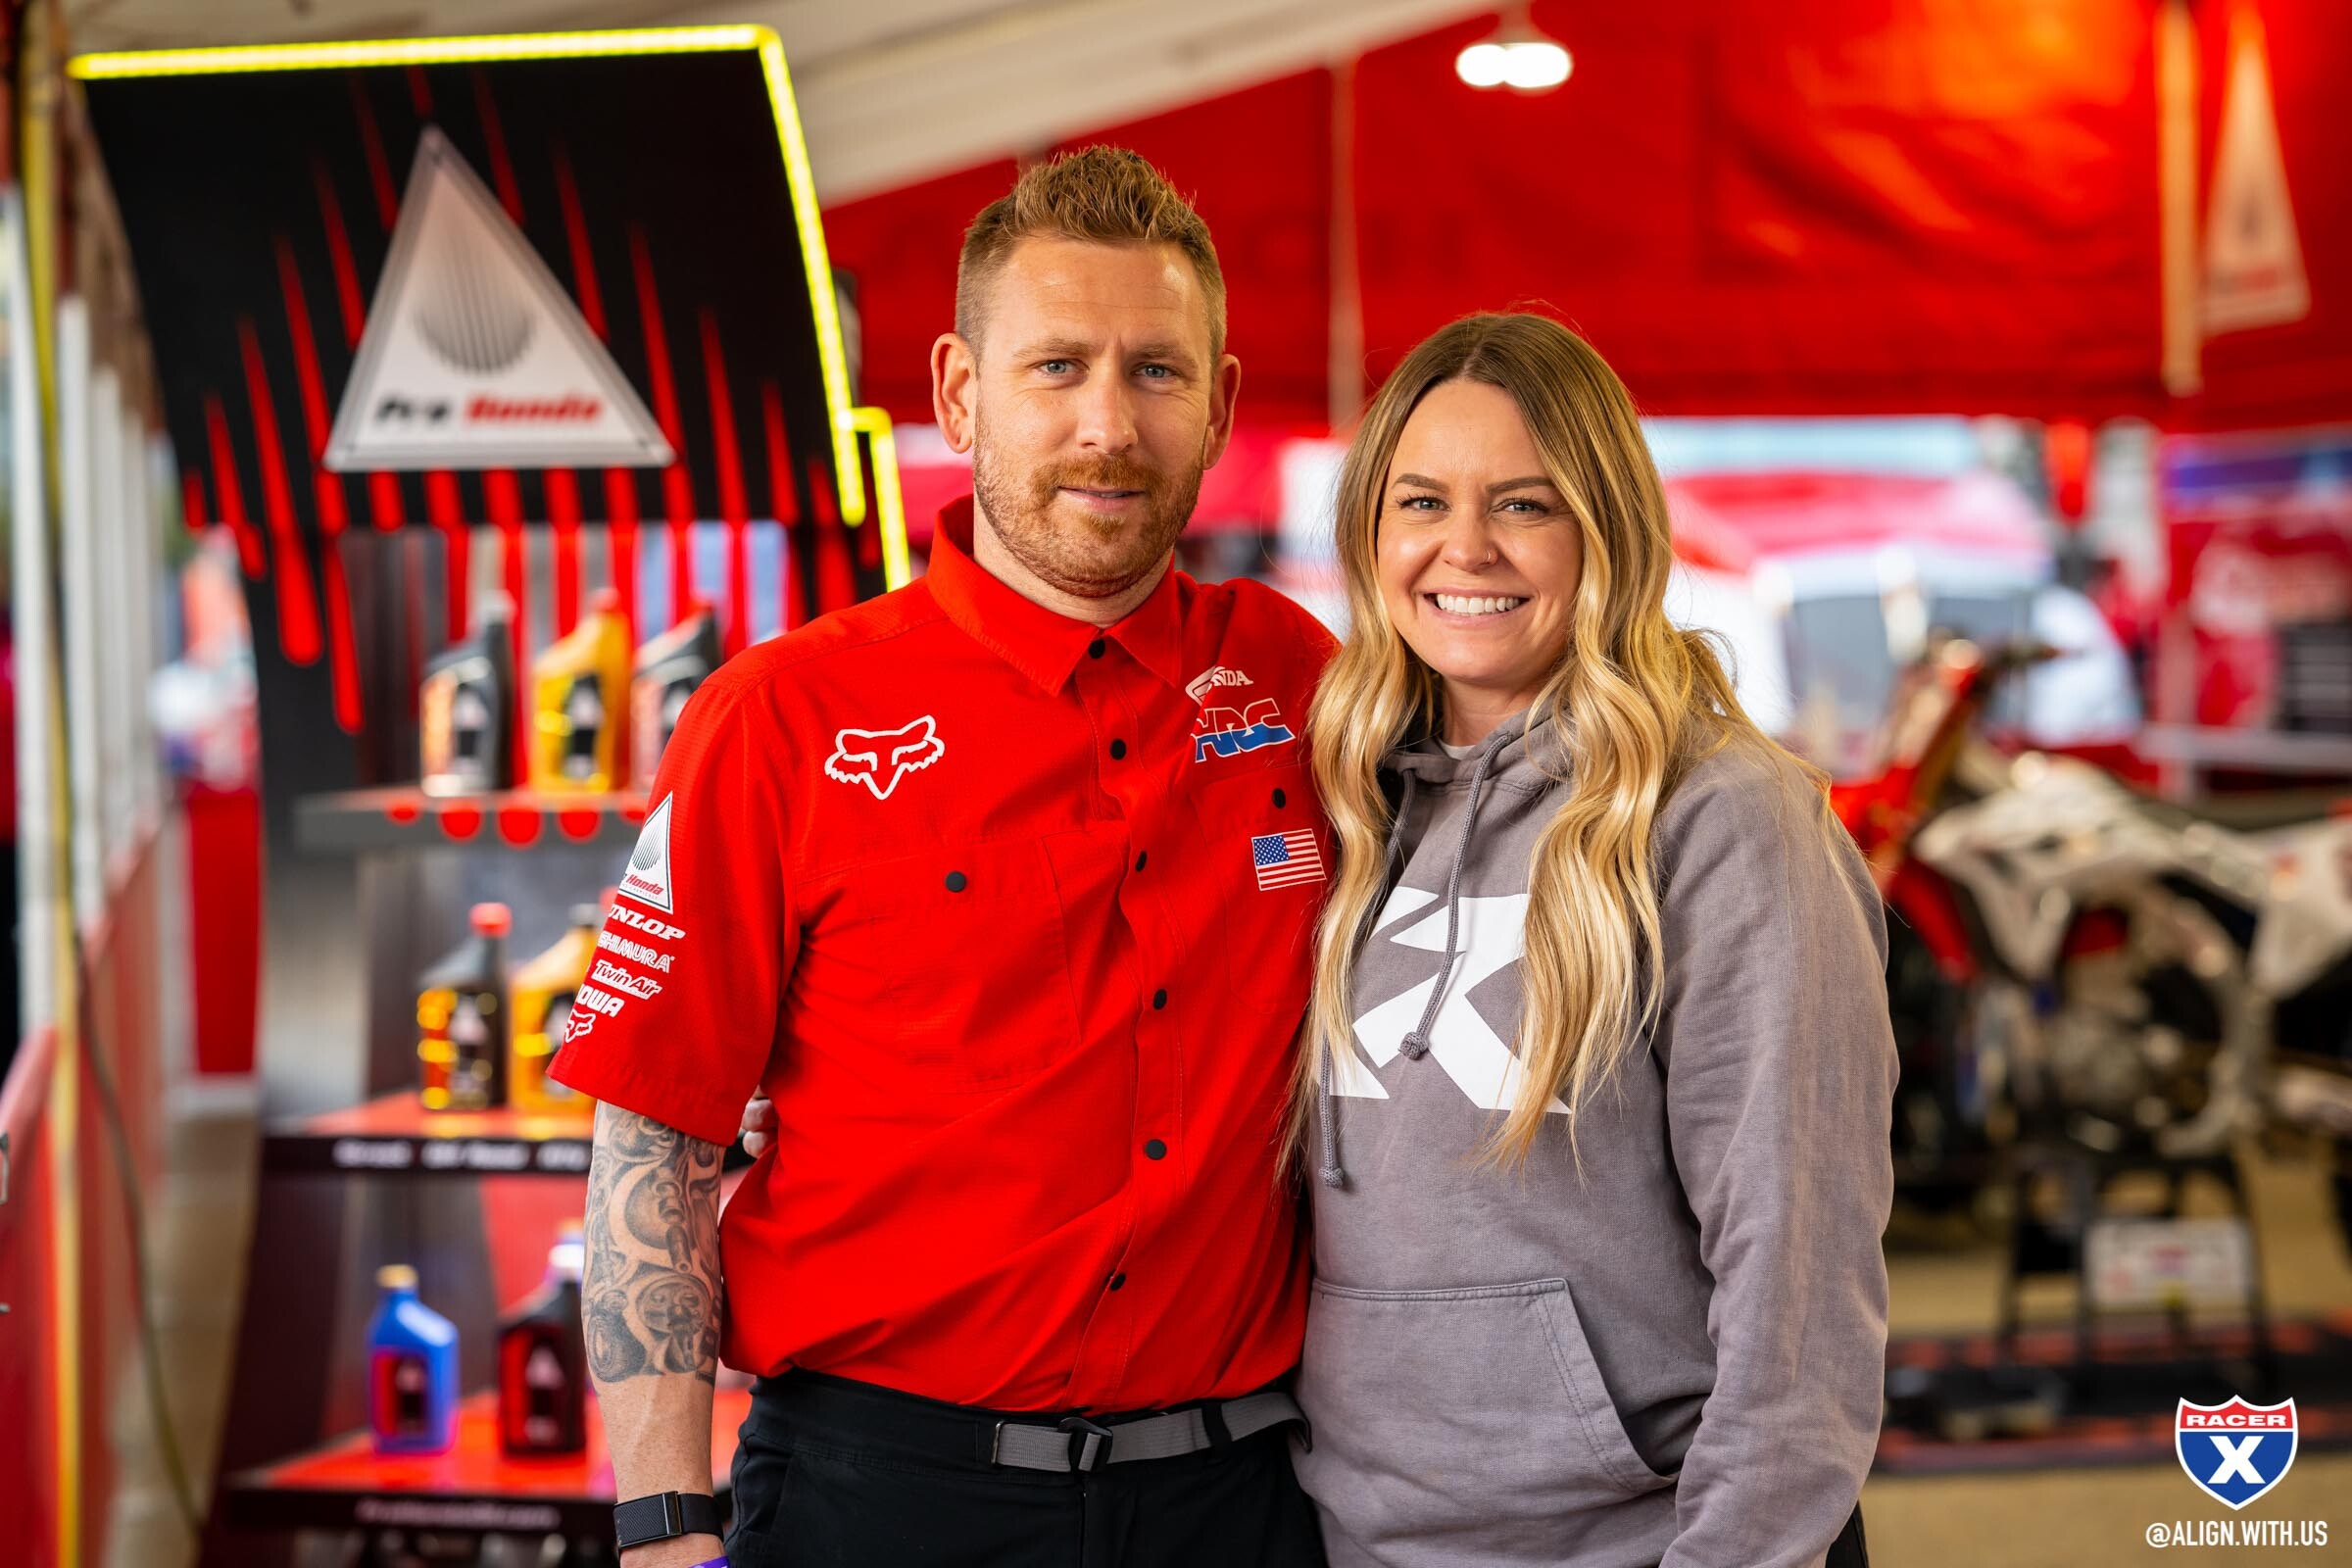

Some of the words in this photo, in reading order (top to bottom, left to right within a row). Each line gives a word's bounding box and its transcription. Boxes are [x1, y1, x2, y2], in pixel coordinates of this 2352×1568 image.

[1210, 669, 1254, 687] NDA
[625, 874, 663, 895] Honda
[609, 904, 686, 940] NLOP
[598, 930, 673, 973] SHIMURA
[576, 983, 625, 1017] OWA
